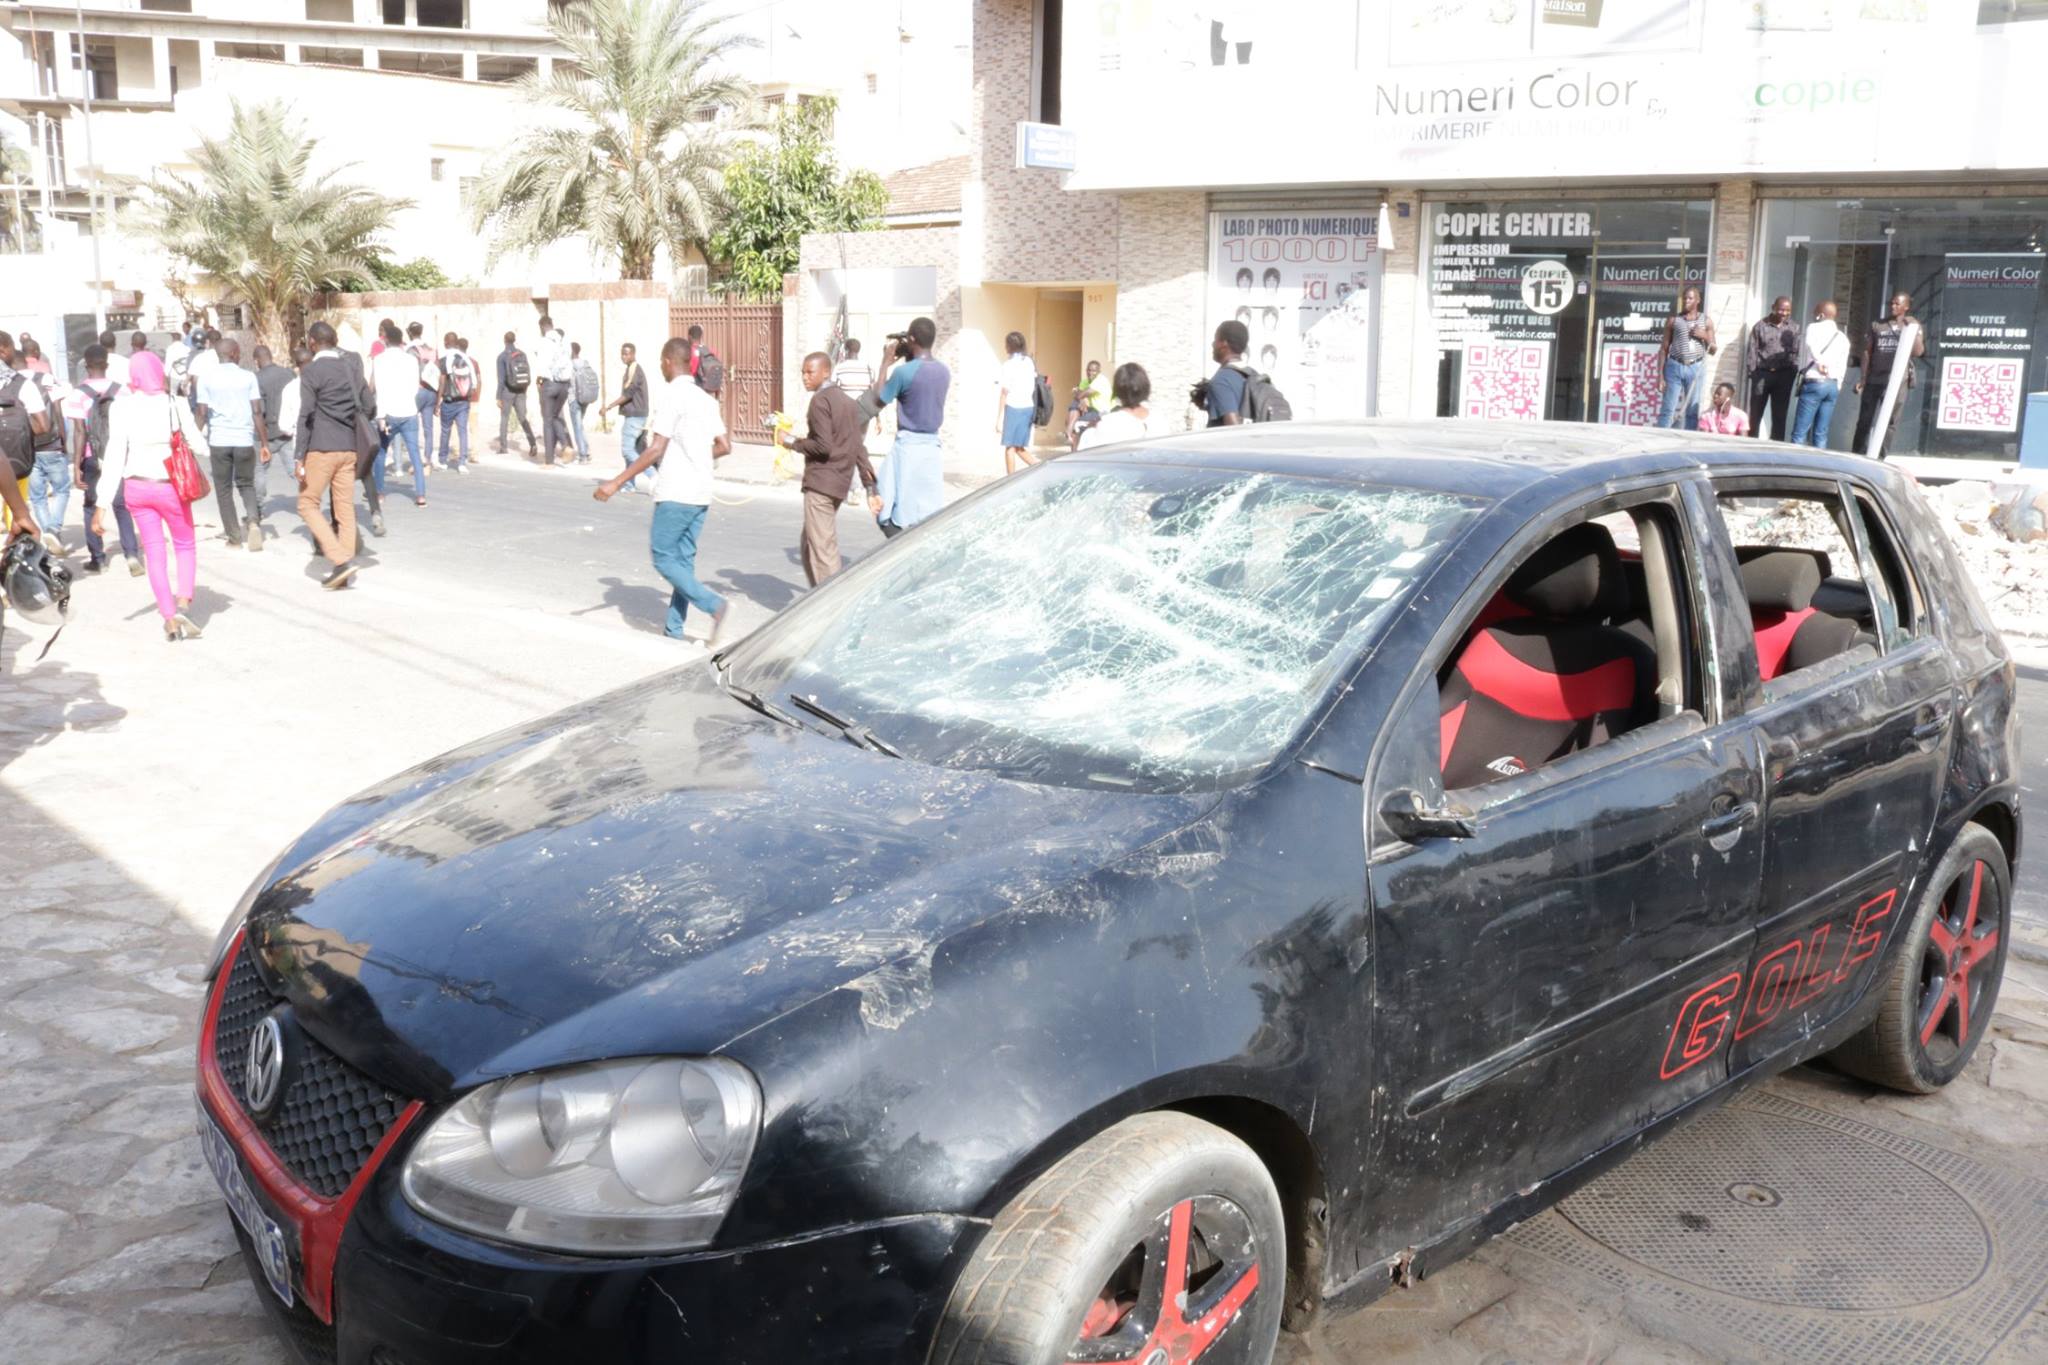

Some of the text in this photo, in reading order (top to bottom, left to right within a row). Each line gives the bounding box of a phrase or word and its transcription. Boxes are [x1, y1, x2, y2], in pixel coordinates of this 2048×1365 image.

[1375, 72, 1638, 116] Numeri Color
[1223, 217, 1378, 237] LABO PHOTO NUMERIQUE
[1435, 212, 1591, 237] COPIE CENTER
[1223, 237, 1378, 263] 1000 F
[1433, 244, 1510, 255] IMPRESSION
[1432, 270, 1476, 282] TIRAGE
[1529, 269, 1568, 279] COPIE
[1603, 265, 1706, 281] Numeri Color
[1947, 266, 2041, 280] Numeri Color
[1432, 283, 1453, 291] PLAN
[1630, 301, 1671, 313] VISITEZ
[1502, 314, 1524, 326] SITE
[1527, 314, 1552, 326] WEB
[1969, 315, 2007, 325] VISITEZ
[1946, 327, 2028, 338] NOTRE SITE WEB
[1939, 341, 2032, 351] www.numericolor.com
[1660, 888, 1897, 1080] GOLF
